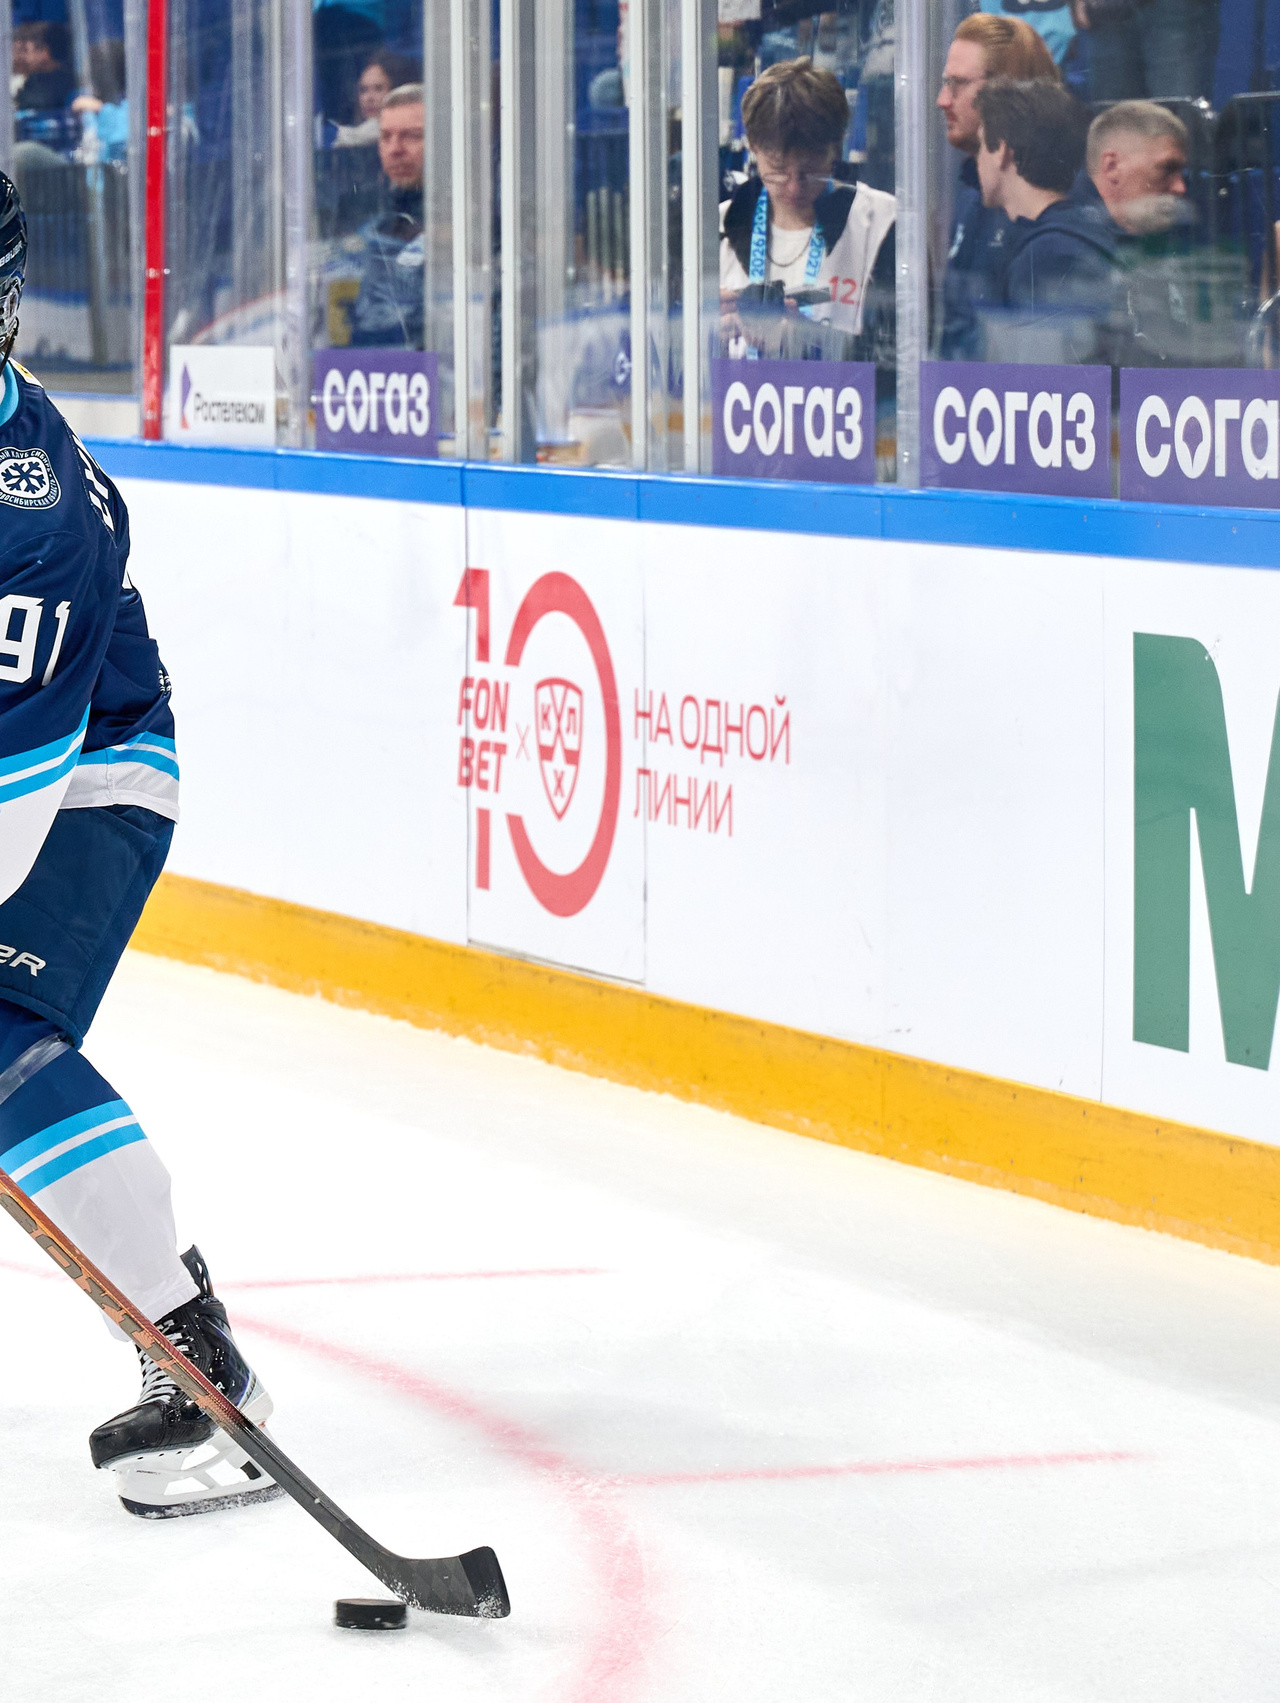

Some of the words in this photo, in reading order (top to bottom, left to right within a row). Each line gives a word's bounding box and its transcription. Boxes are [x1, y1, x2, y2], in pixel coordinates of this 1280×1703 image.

[829, 276, 857, 305] 12
[194, 393, 266, 424] Ростелеком
[457, 676, 509, 733] FON
[634, 687, 673, 746] НА
[680, 694, 790, 767] ОДНОЙ
[457, 737, 507, 793] BET
[634, 767, 732, 837] ЛИНИИ
